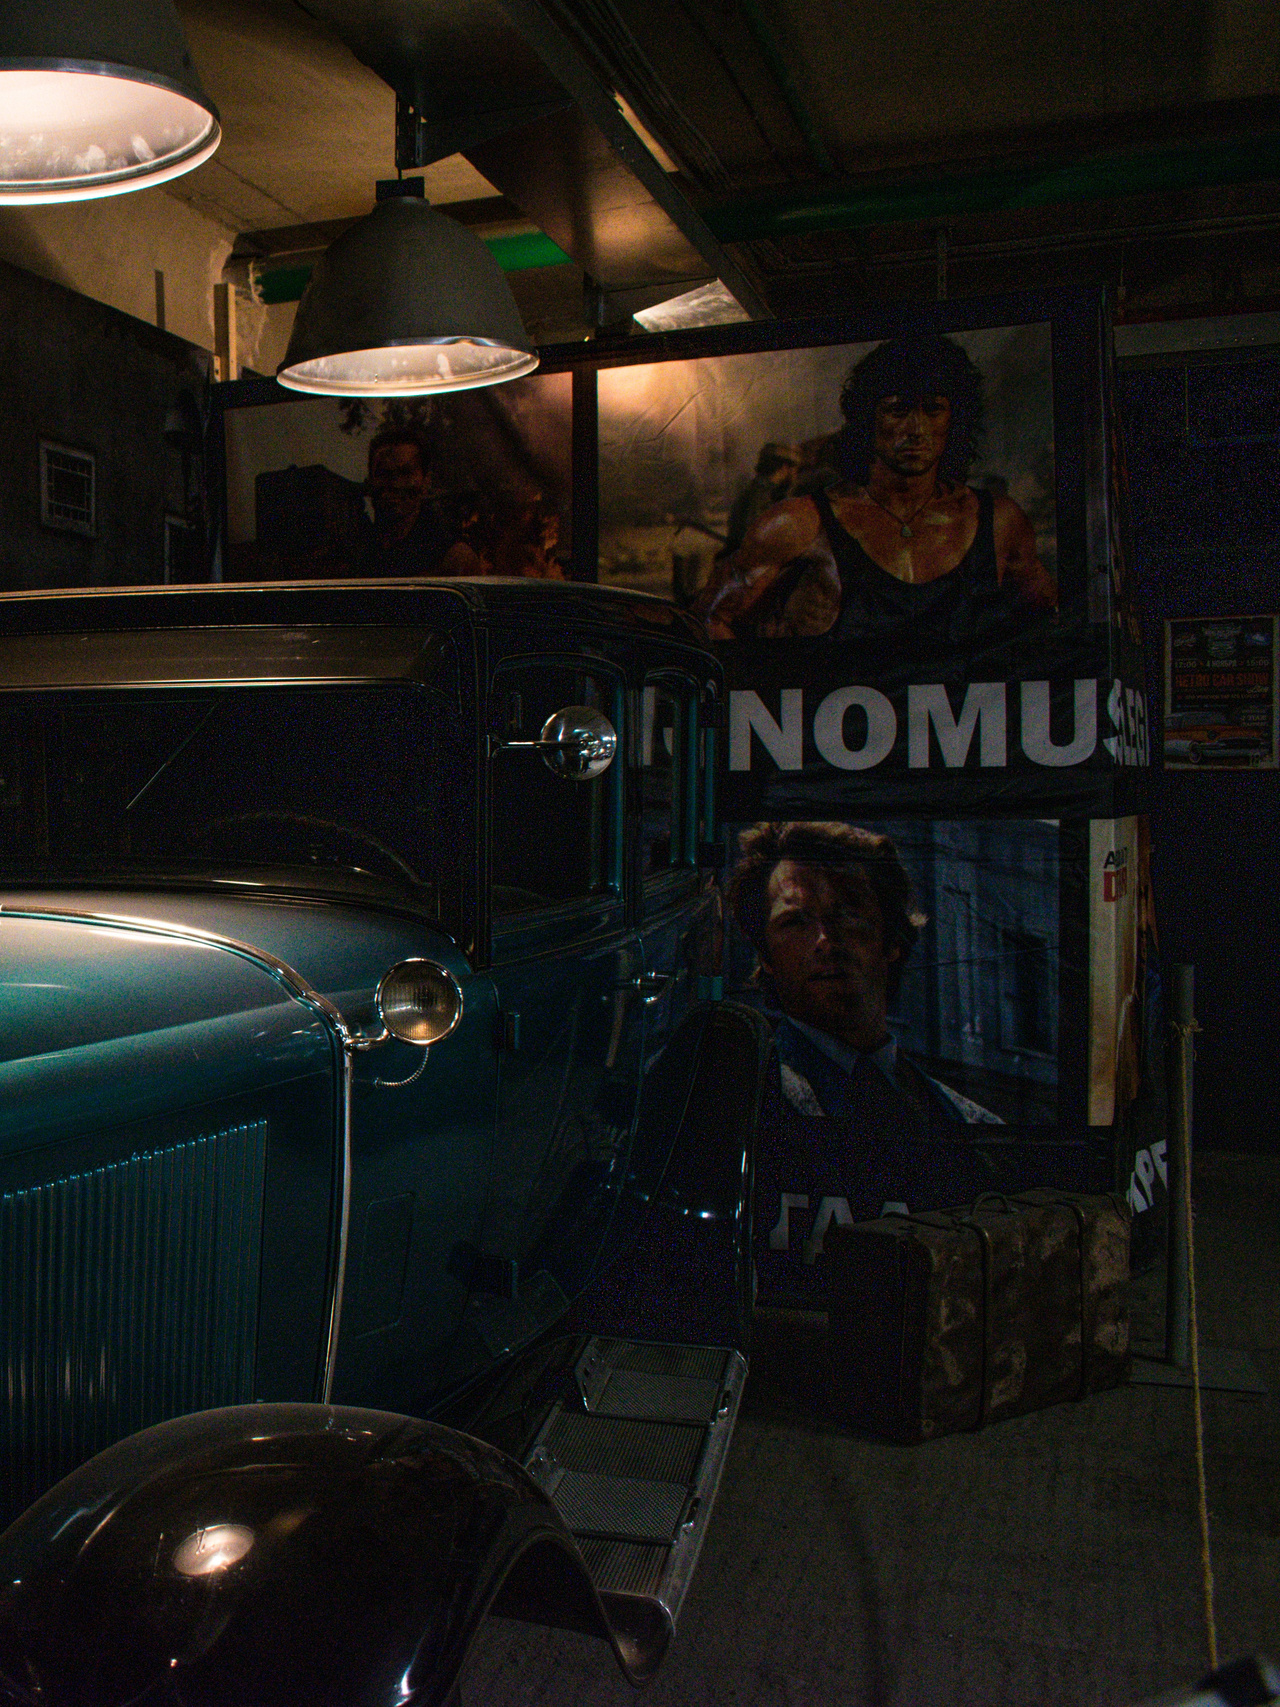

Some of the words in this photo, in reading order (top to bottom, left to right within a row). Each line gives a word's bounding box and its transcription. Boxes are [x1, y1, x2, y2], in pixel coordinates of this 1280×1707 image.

[1175, 673, 1210, 688] RETRO
[1212, 673, 1235, 687] CAR
[1237, 671, 1270, 686] SHOW
